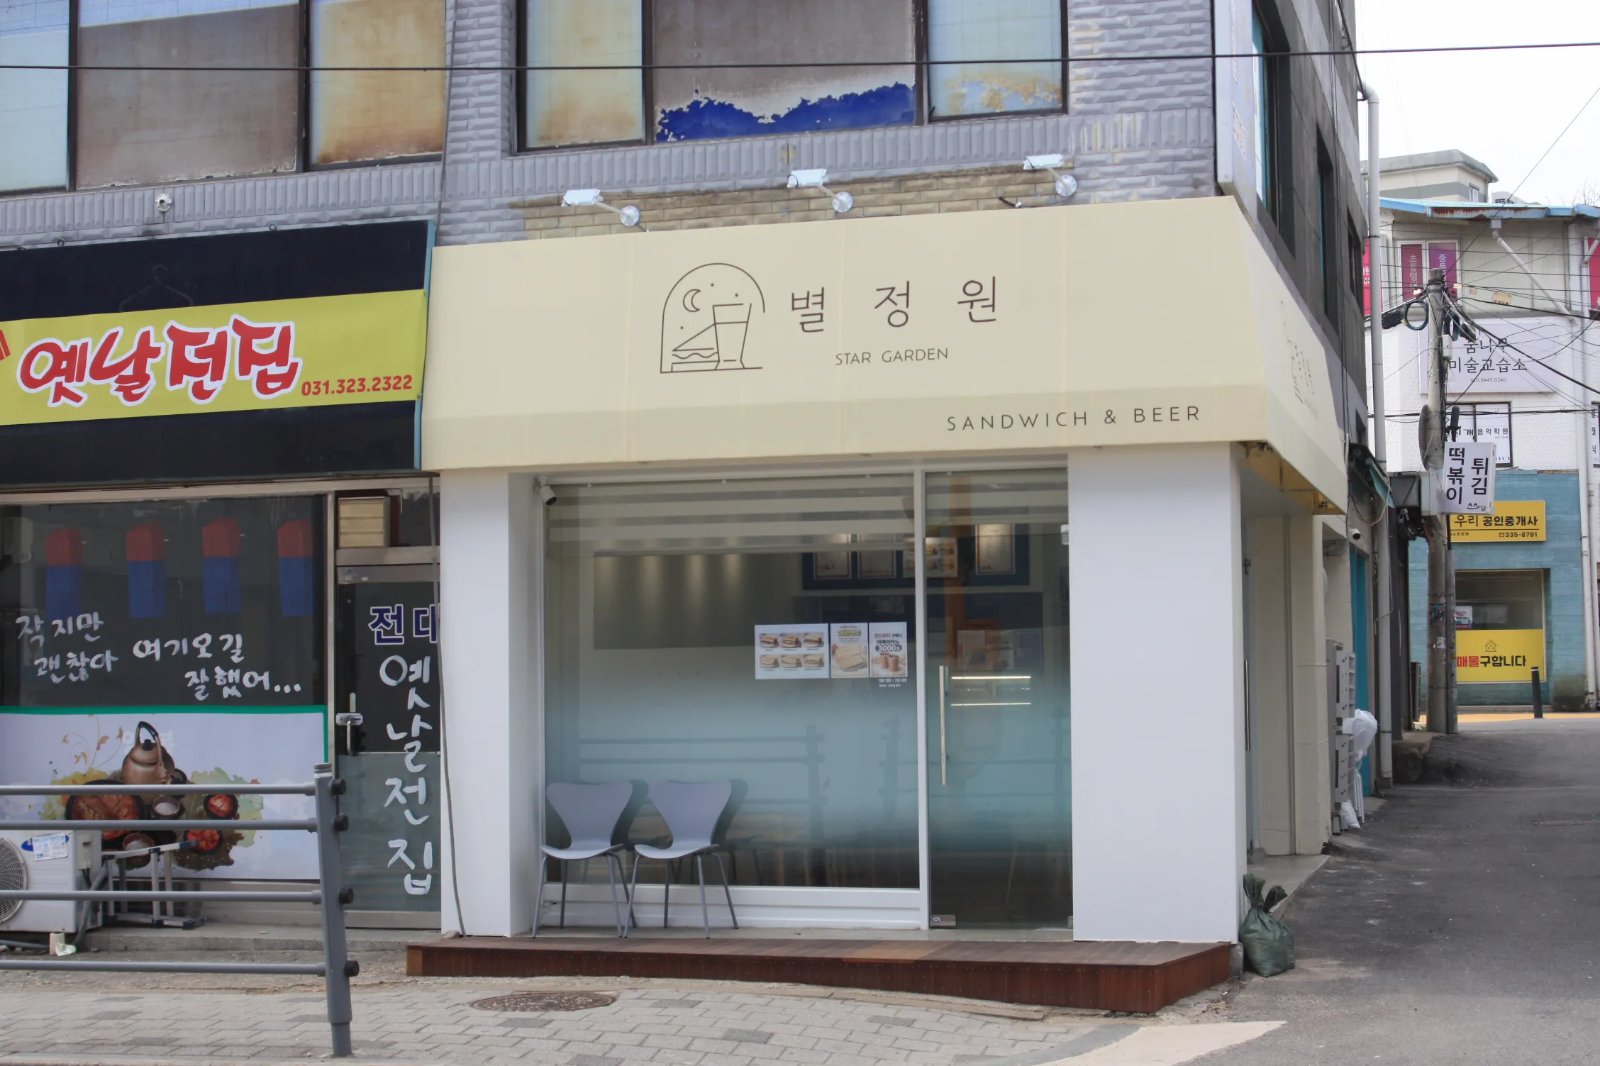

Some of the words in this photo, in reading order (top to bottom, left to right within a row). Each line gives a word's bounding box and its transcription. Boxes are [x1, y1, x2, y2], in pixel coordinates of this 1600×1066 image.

[18, 314, 302, 407] 옛날전집
[834, 352, 872, 366] STAR
[881, 347, 949, 364] GARDEN
[1449, 357, 1527, 373] 미술교습소
[301, 374, 413, 397] 031.323.2322
[947, 411, 1088, 431] SANDWICH
[1104, 409, 1116, 424] &
[1133, 406, 1200, 423] BEER
[1446, 447, 1466, 505] 떡볶이
[1471, 457, 1489, 496] 튀김
[1454, 514, 1479, 528] 우리
[1482, 515, 1538, 527] 공인중개사
[34, 649, 119, 684] 괜찮아
[379, 654, 433, 896] 옛날전집
